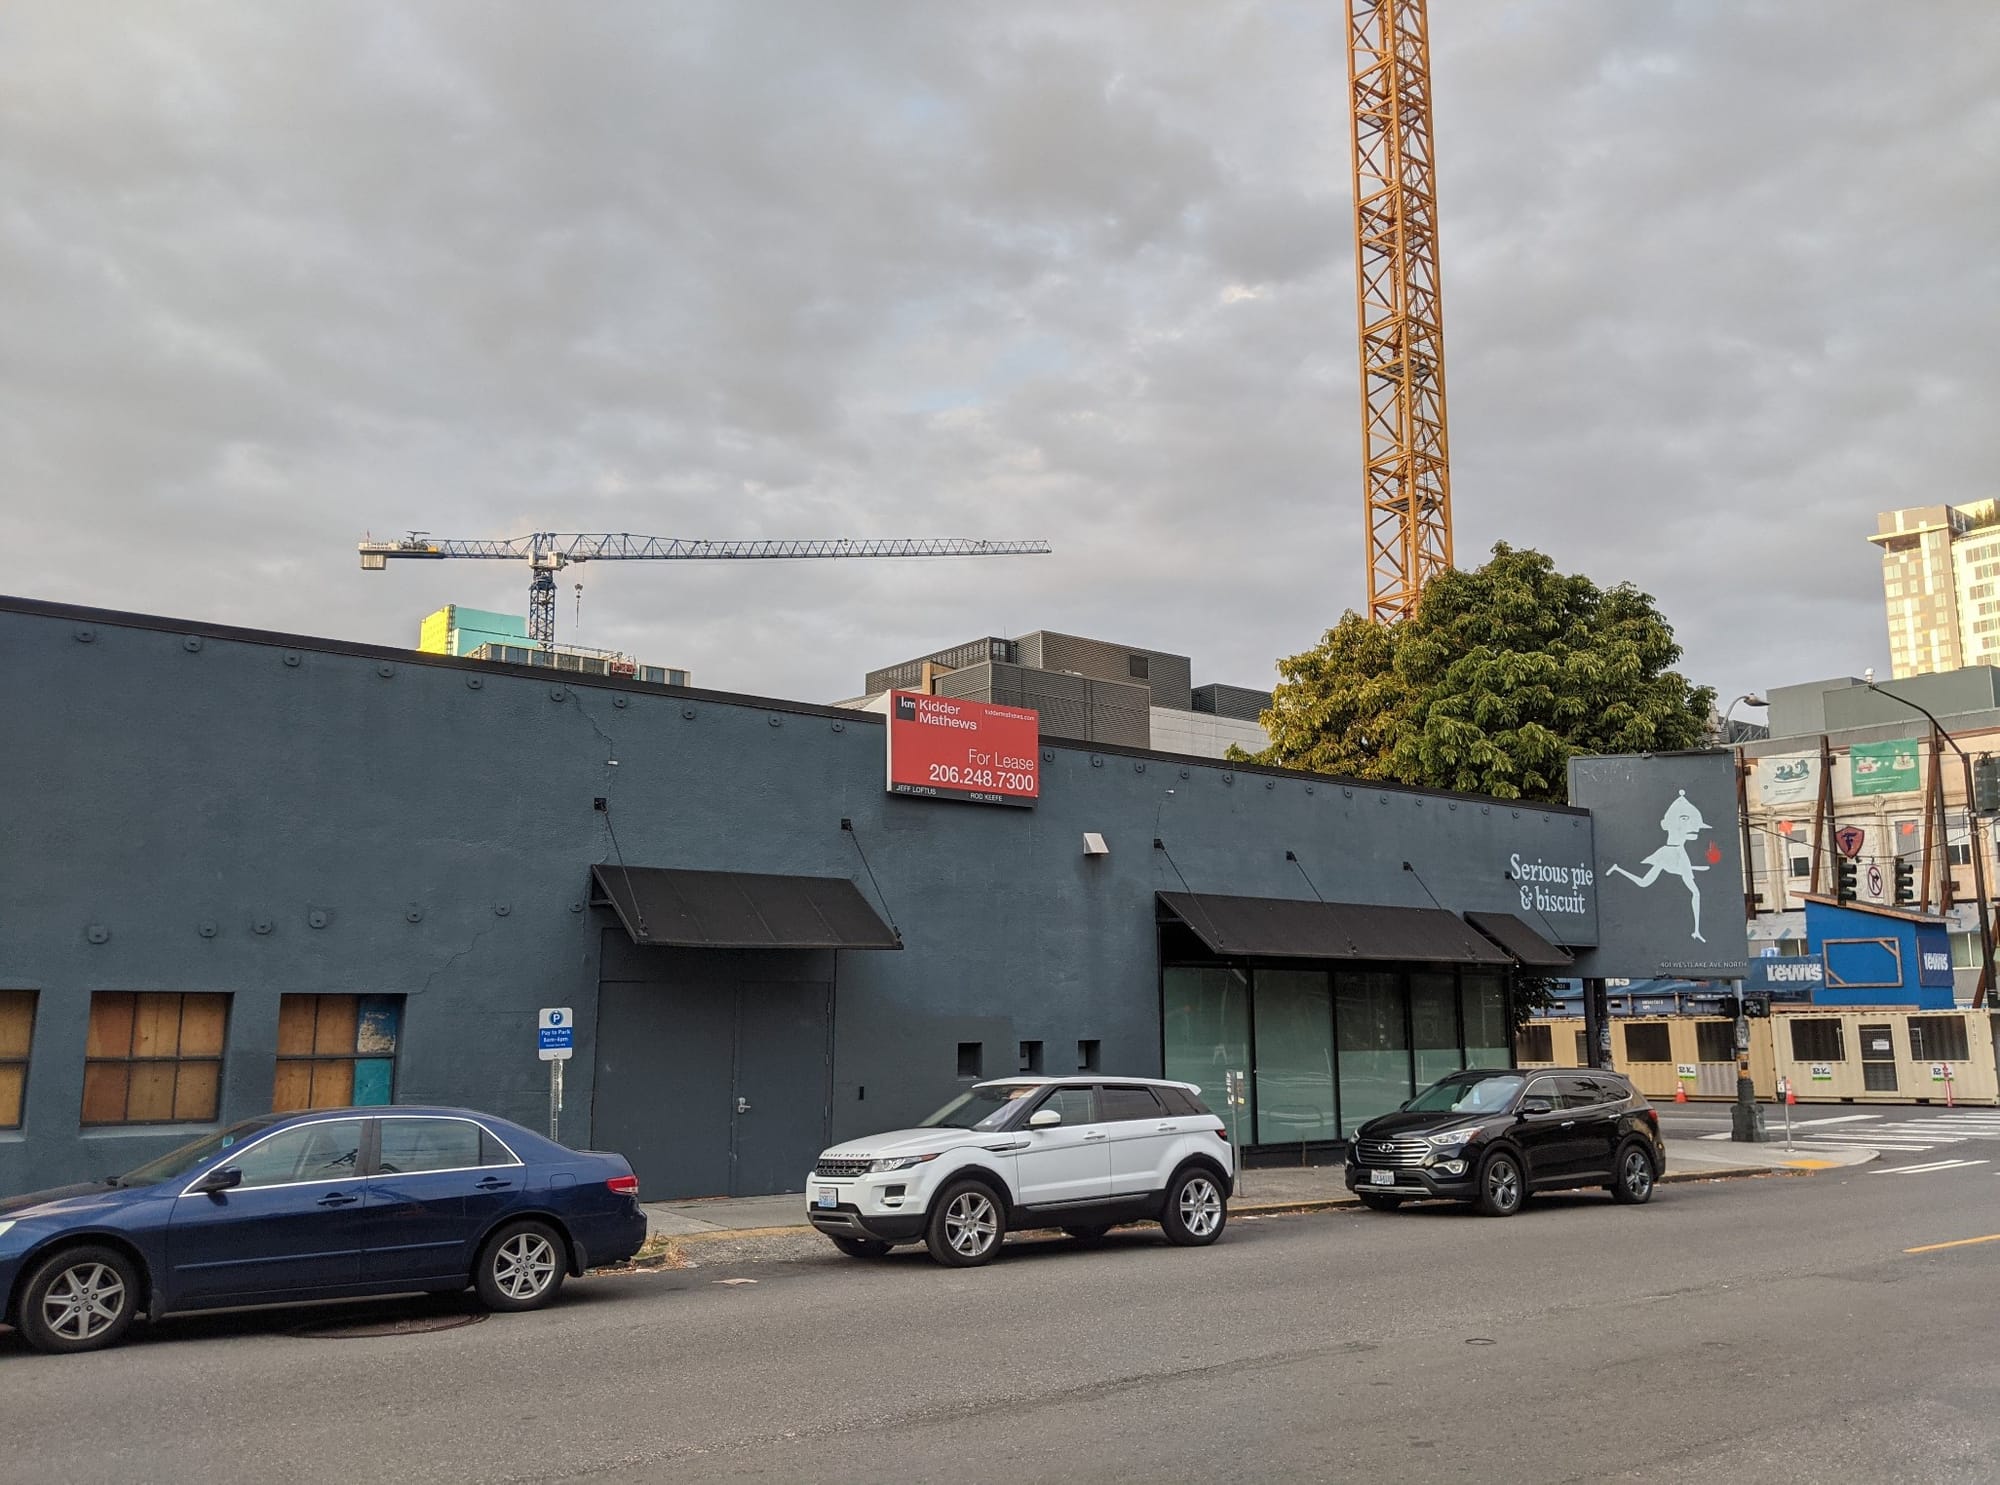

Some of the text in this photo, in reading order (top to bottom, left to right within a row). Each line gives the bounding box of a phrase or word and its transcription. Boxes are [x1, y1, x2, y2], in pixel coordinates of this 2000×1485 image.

[919, 699, 961, 715] Kidder
[919, 711, 977, 730] Mathews
[968, 748, 1034, 771] For Lease
[929, 763, 1034, 791] 206.248.7300
[896, 784, 937, 795] JEFF LOFTUS
[1510, 852, 1593, 890] Serious pie
[1519, 885, 1586, 914] & biscuit
[1660, 961, 1747, 969] 401 WESTLAKE AVE NORTH
[553, 1013, 560, 1022] P
